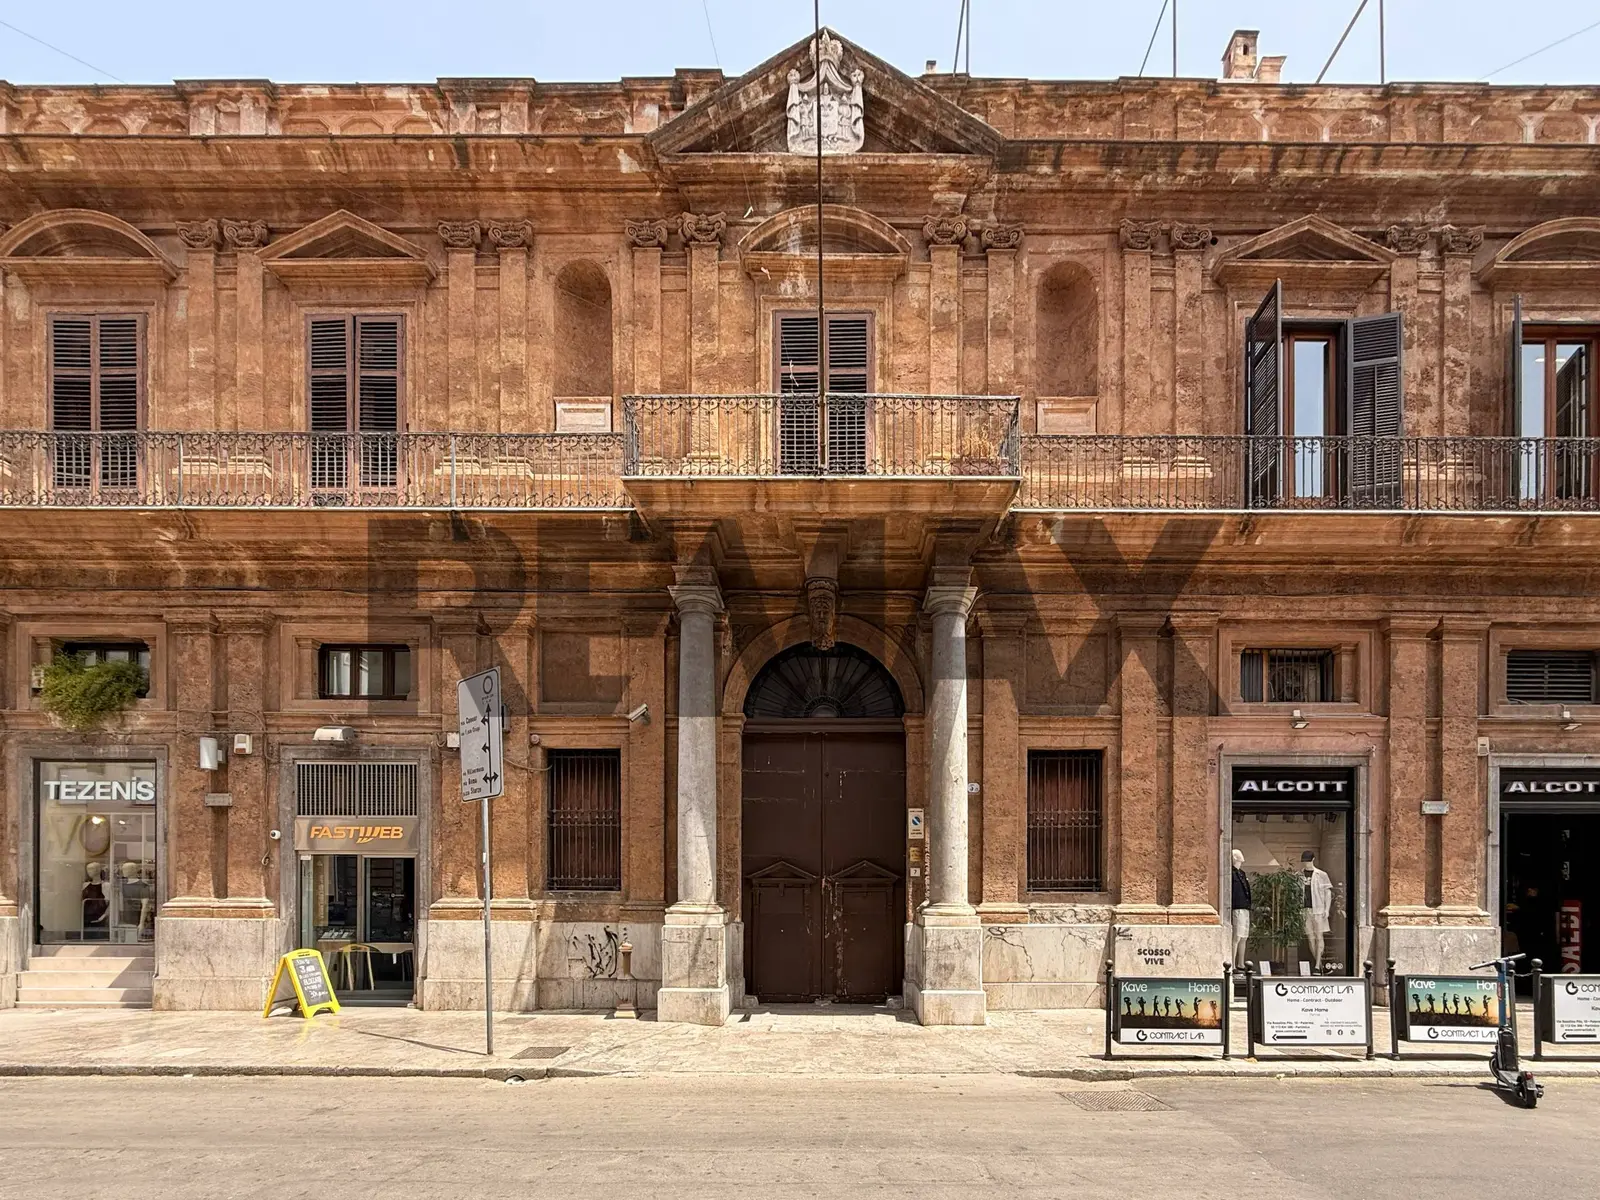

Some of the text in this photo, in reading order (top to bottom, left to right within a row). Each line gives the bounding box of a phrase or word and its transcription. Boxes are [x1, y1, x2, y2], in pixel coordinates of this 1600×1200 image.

[1239, 780, 1348, 792] ALCOTT
[1507, 781, 1600, 793] ALCOT
[309, 826, 404, 844] FASTWEB
[1137, 948, 1171, 957] SCOSSO
[1144, 958, 1165, 966] VIVE
[1121, 981, 1148, 993] Kave
[1188, 982, 1221, 993] Home
[1408, 978, 1436, 990] Kave
[1290, 985, 1354, 994] CONTRACT LAB
[1149, 1031, 1205, 1040] CONTRACT LAB
[1441, 1029, 1480, 1038] CONTRACT
